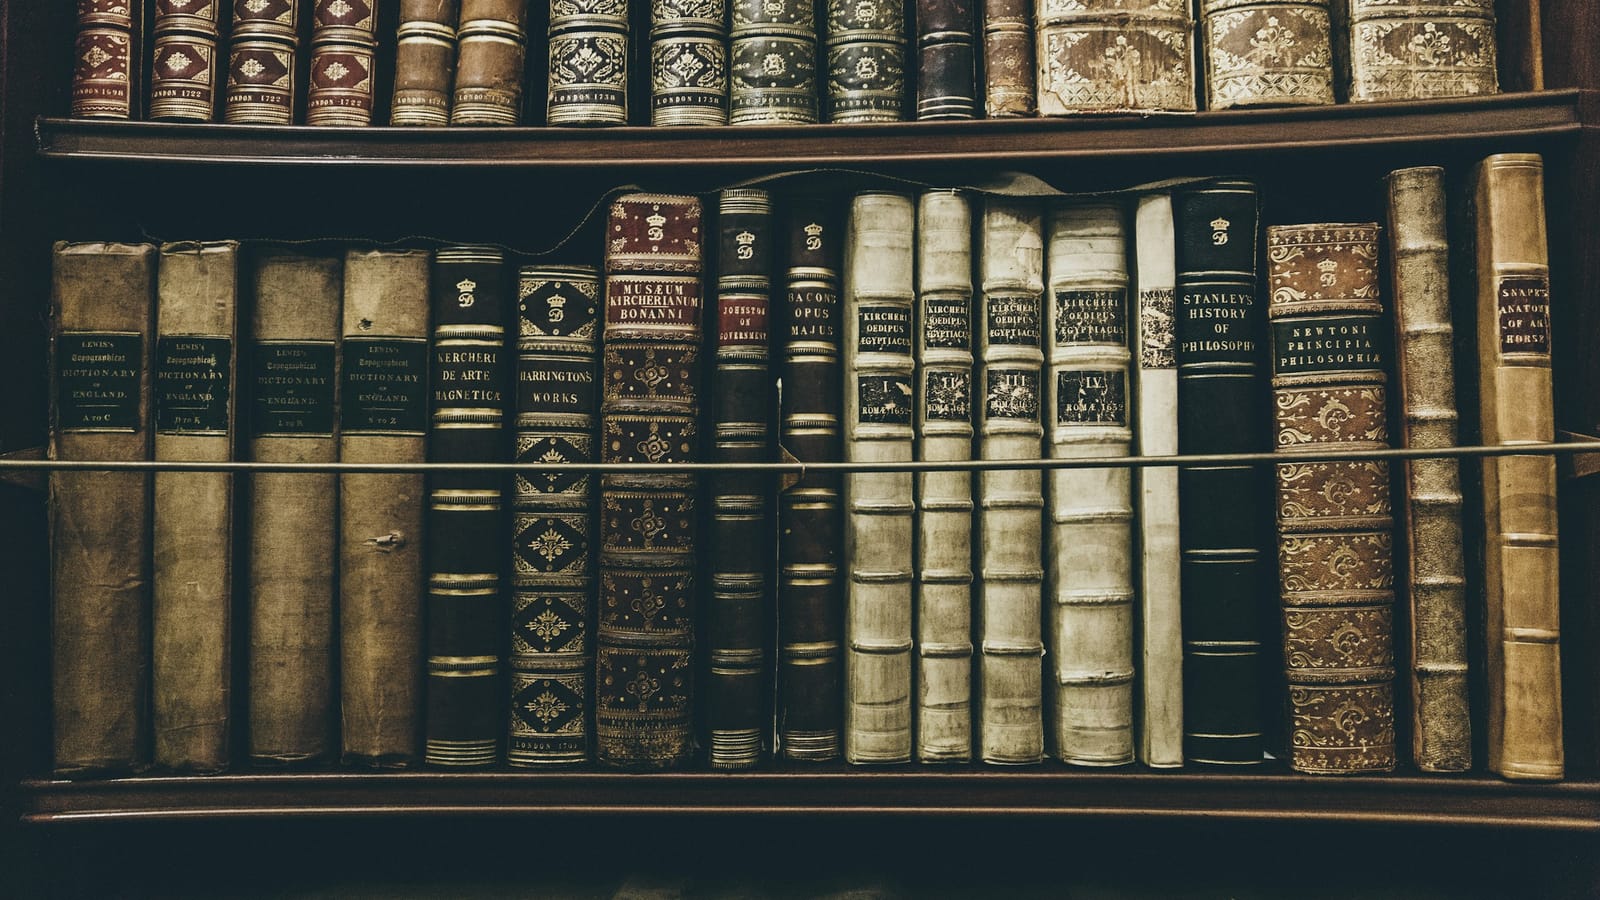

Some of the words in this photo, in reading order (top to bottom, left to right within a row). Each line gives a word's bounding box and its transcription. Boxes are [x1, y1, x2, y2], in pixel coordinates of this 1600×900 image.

[554, 93, 590, 102] LONDON
[657, 97, 692, 105] LONDON
[739, 97, 780, 105] LONDON
[835, 99, 876, 108] LONDON
[623, 284, 684, 295] MUSÆUM
[610, 295, 698, 307] KIRCHERIANUM
[1064, 298, 1119, 308] KIRCHERI
[620, 308, 682, 320] BONANNI
[794, 307, 829, 319] OPUS
[928, 305, 968, 314] KIRCHERI
[1189, 308, 1247, 319] HISTORY
[864, 312, 908, 321] KIRCHERI
[995, 316, 1034, 324] OEDIPUS
[1068, 311, 1116, 321] OEDIPUS
[739, 318, 751, 326] ON
[1508, 319, 1523, 328] OF
[791, 325, 833, 336] MAJUS
[866, 324, 904, 333] OEDIPUS
[1214, 324, 1230, 334] OF
[1293, 325, 1367, 337] NEWTONI
[720, 331, 767, 340] GOVERNMENT
[1506, 334, 1545, 344] HORSE
[1288, 339, 1372, 351] PRINCIPIA
[438, 352, 496, 363] KERCHERI
[62, 369, 136, 377] DICTIONARY
[158, 371, 223, 380] DICTIONARY
[350, 373, 418, 382] DICTIONARY
[443, 370, 456, 381] DE
[460, 370, 490, 381] ARTE
[258, 377, 327, 385] DICTIONARY
[1006, 374, 1026, 387] III
[73, 391, 127, 399] ENGLAND.
[532, 392, 578, 404] WORKS
[515, 741, 551, 750] LONDON
